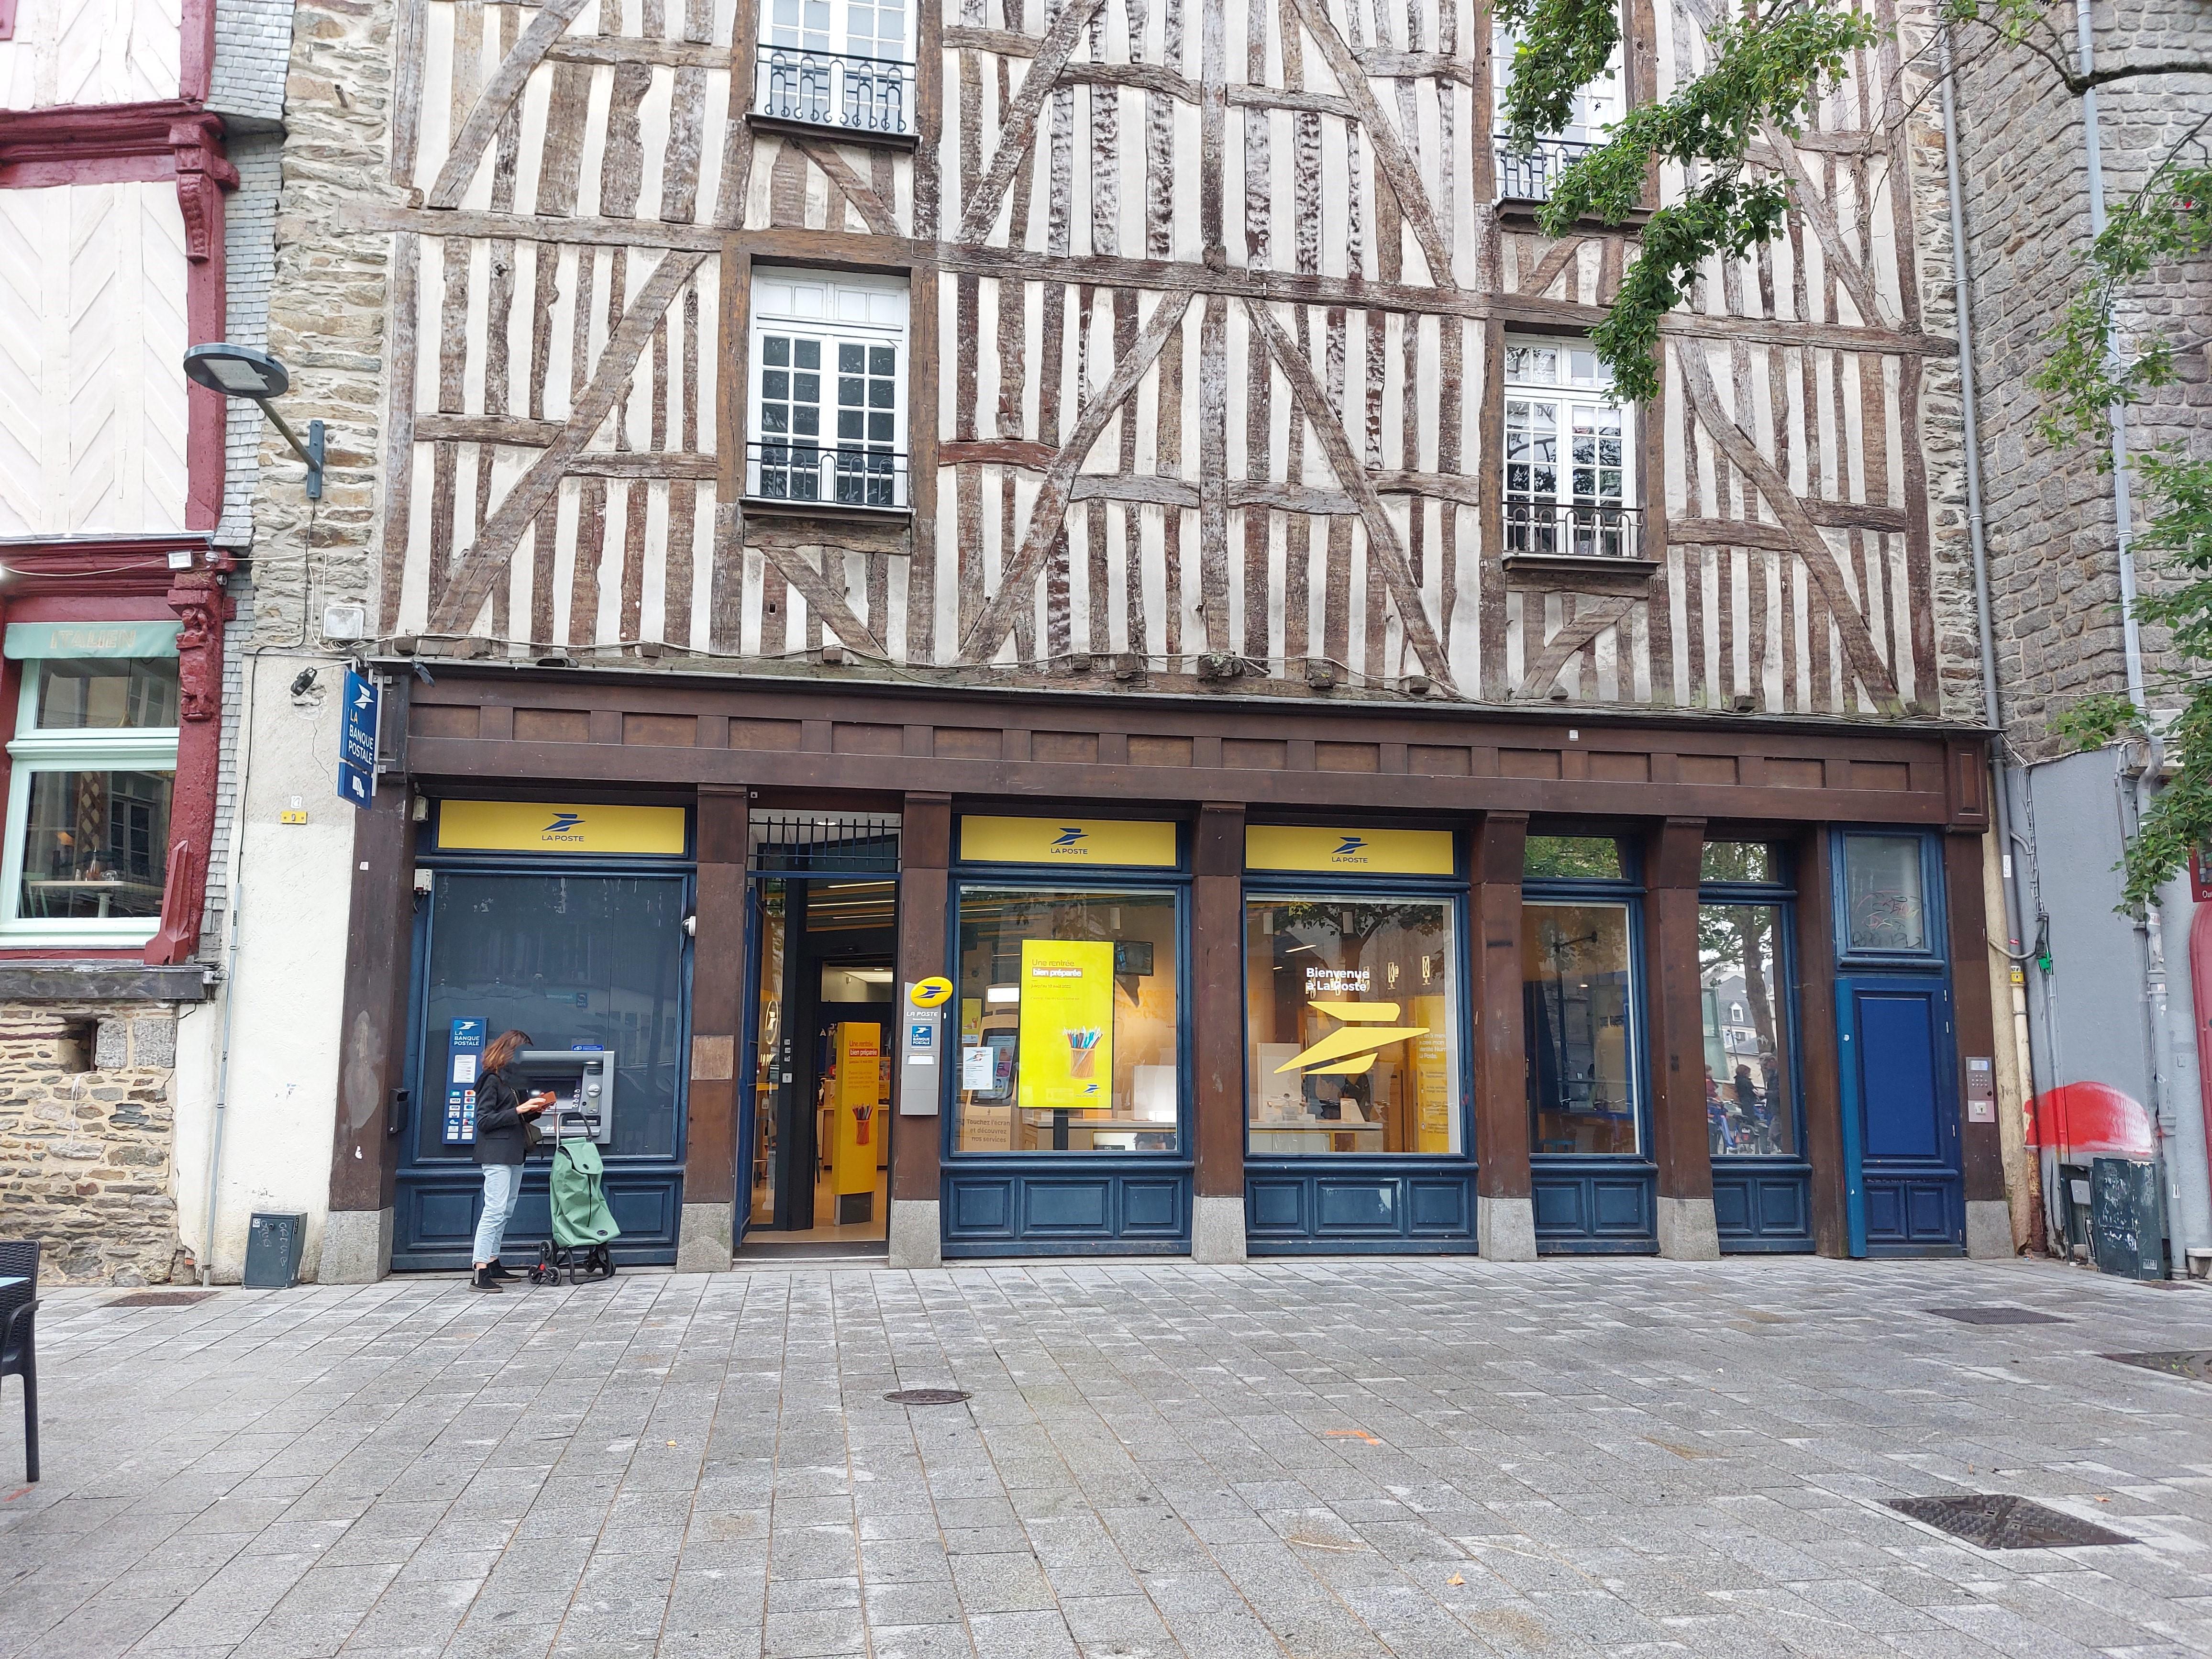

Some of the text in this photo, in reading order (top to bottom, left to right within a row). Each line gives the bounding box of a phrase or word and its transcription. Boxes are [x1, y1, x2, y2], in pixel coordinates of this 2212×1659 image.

[50, 630, 136, 649] ITALIEN
[350, 708, 358, 724] LA
[349, 724, 373, 750] BANQUE
[348, 739, 373, 765] POSTALE
[1050, 969, 1082, 977] préparée
[1306, 967, 1370, 979] Bienvenue
[1307, 980, 1367, 991] à La Poste
[819, 1028, 826, 1036] À
